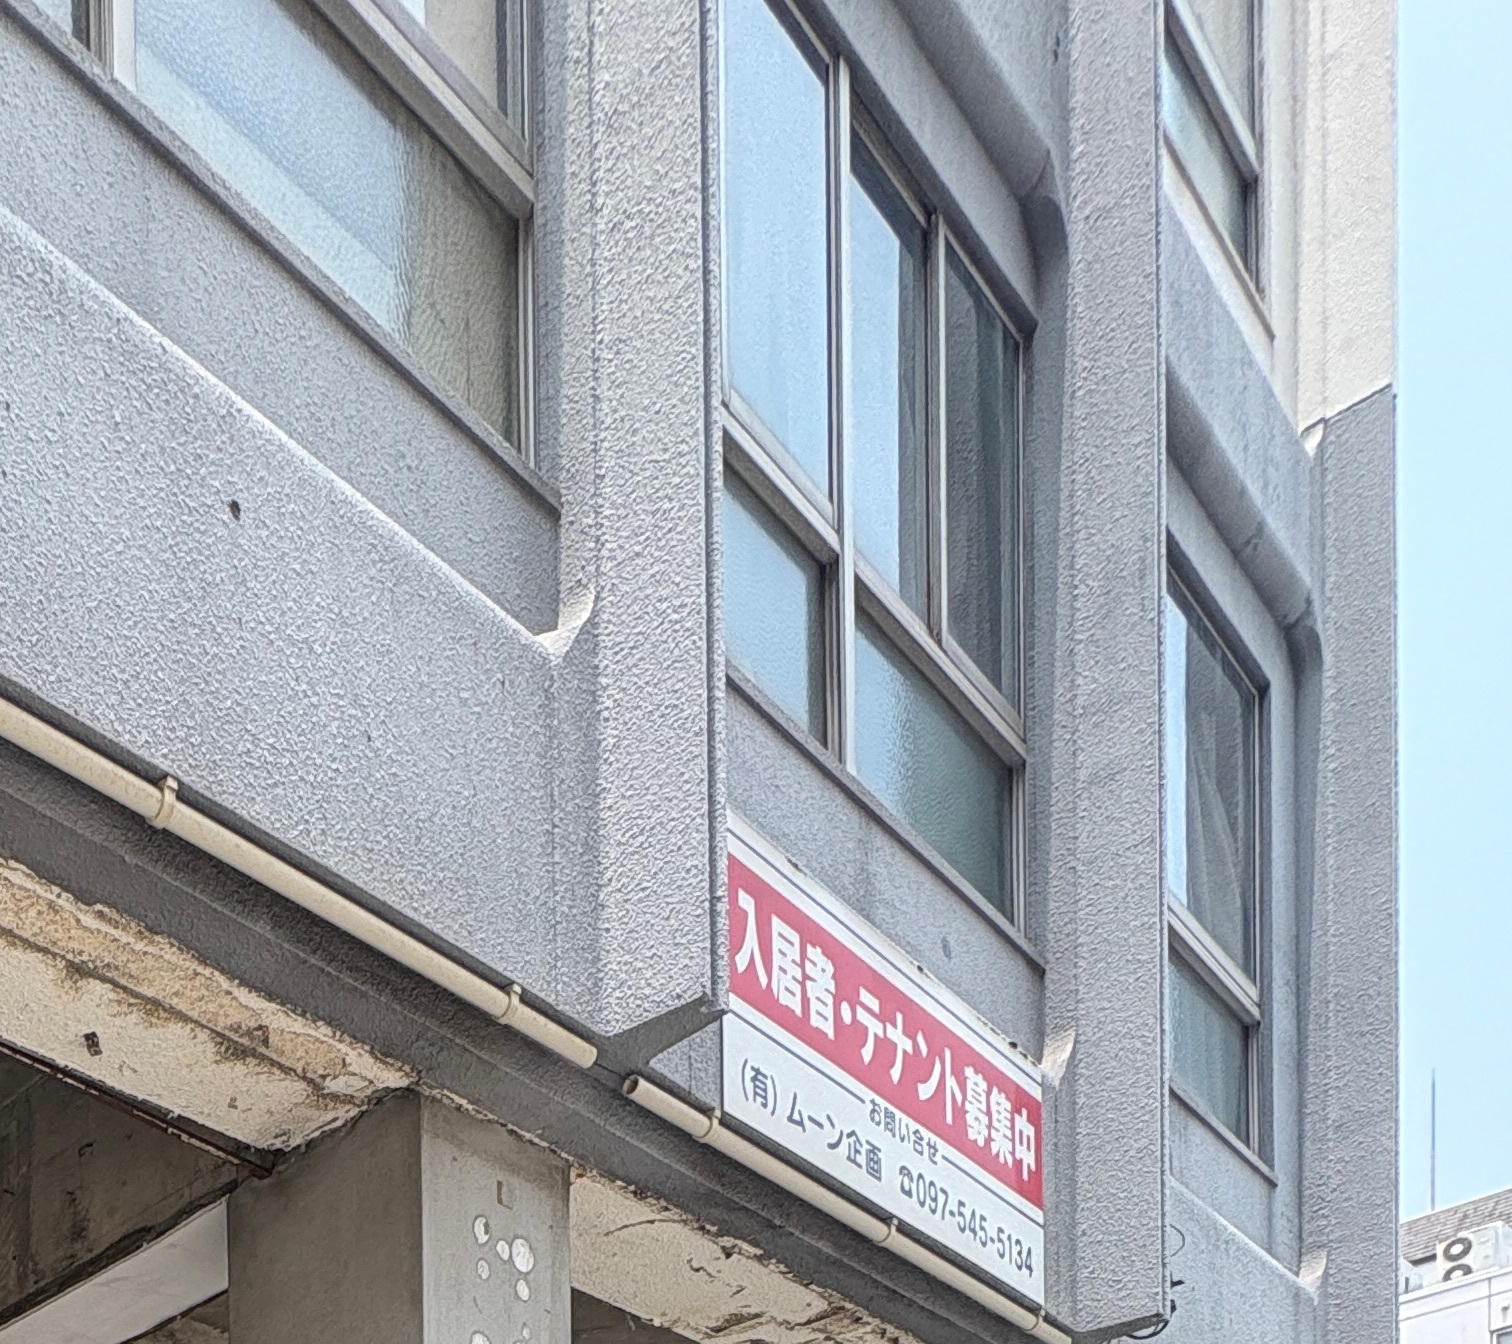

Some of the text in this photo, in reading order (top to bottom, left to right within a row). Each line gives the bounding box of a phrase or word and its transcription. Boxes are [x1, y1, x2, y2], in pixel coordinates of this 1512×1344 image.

[734, 887, 1036, 1182] 入居者・テナント募集中
[868, 1098, 939, 1165] お問い合せ
[916, 1172, 1034, 1278] 097-545-5134
